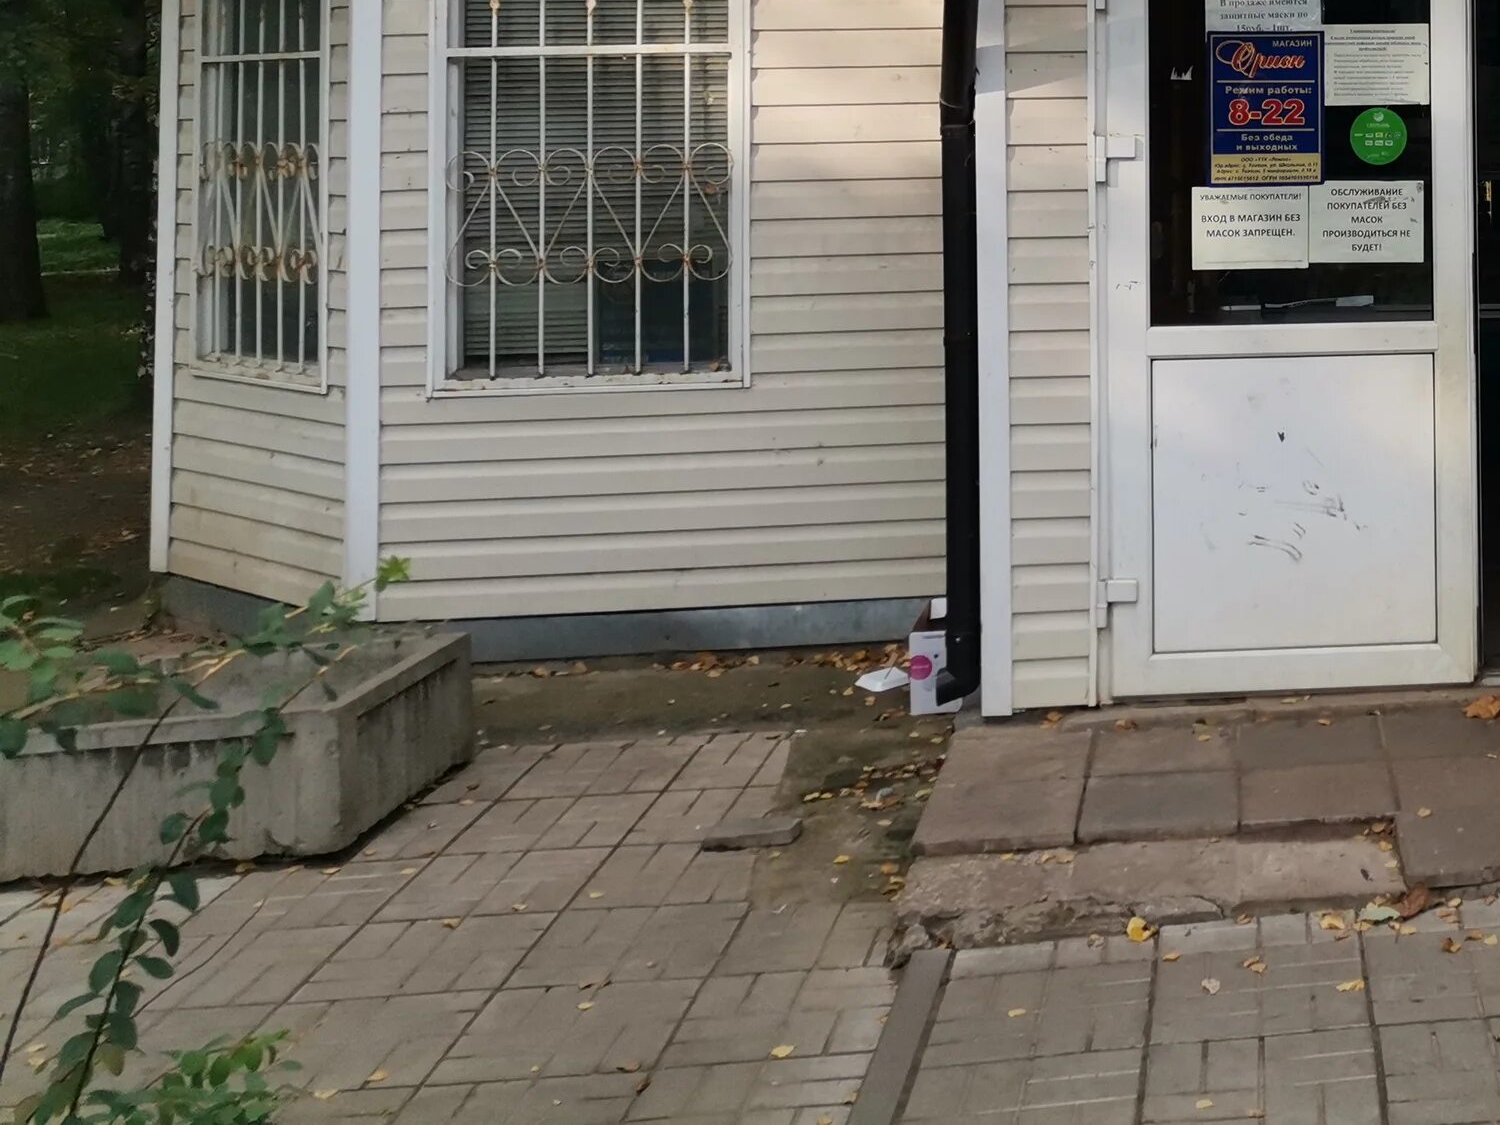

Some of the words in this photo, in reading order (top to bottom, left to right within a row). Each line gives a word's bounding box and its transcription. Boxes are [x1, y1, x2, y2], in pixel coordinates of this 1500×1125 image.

[1220, 0, 1226, 7] В
[1215, 40, 1306, 78] Орион
[1225, 86, 1264, 94] Режим
[1267, 86, 1312, 96] работы:
[1228, 98, 1306, 126] 8-22
[1263, 134, 1293, 142] обеда
[1250, 193, 1302, 201] ПОКУПАТЕЛИ!
[1331, 188, 1403, 197] ОБСЛУЖИВАНИЕ
[1327, 201, 1390, 210] ПОКУПАТЕЛЕЙ
[1392, 202, 1407, 210] БЕЗ
[1201, 215, 1227, 223] ВХОД
[1238, 214, 1282, 222] МАГАЗИН
[1284, 214, 1301, 222] БЕЗ
[1351, 216, 1383, 224] МАСОК
[1206, 229, 1241, 237] МАСОК
[1243, 229, 1296, 238] ЗАПРЕЩЕН.
[1322, 230, 1398, 239] ПРОИЗВОДИТЬСЯ
[1400, 230, 1411, 238] НЕ
[1351, 244, 1382, 252] БУДЕТ!
